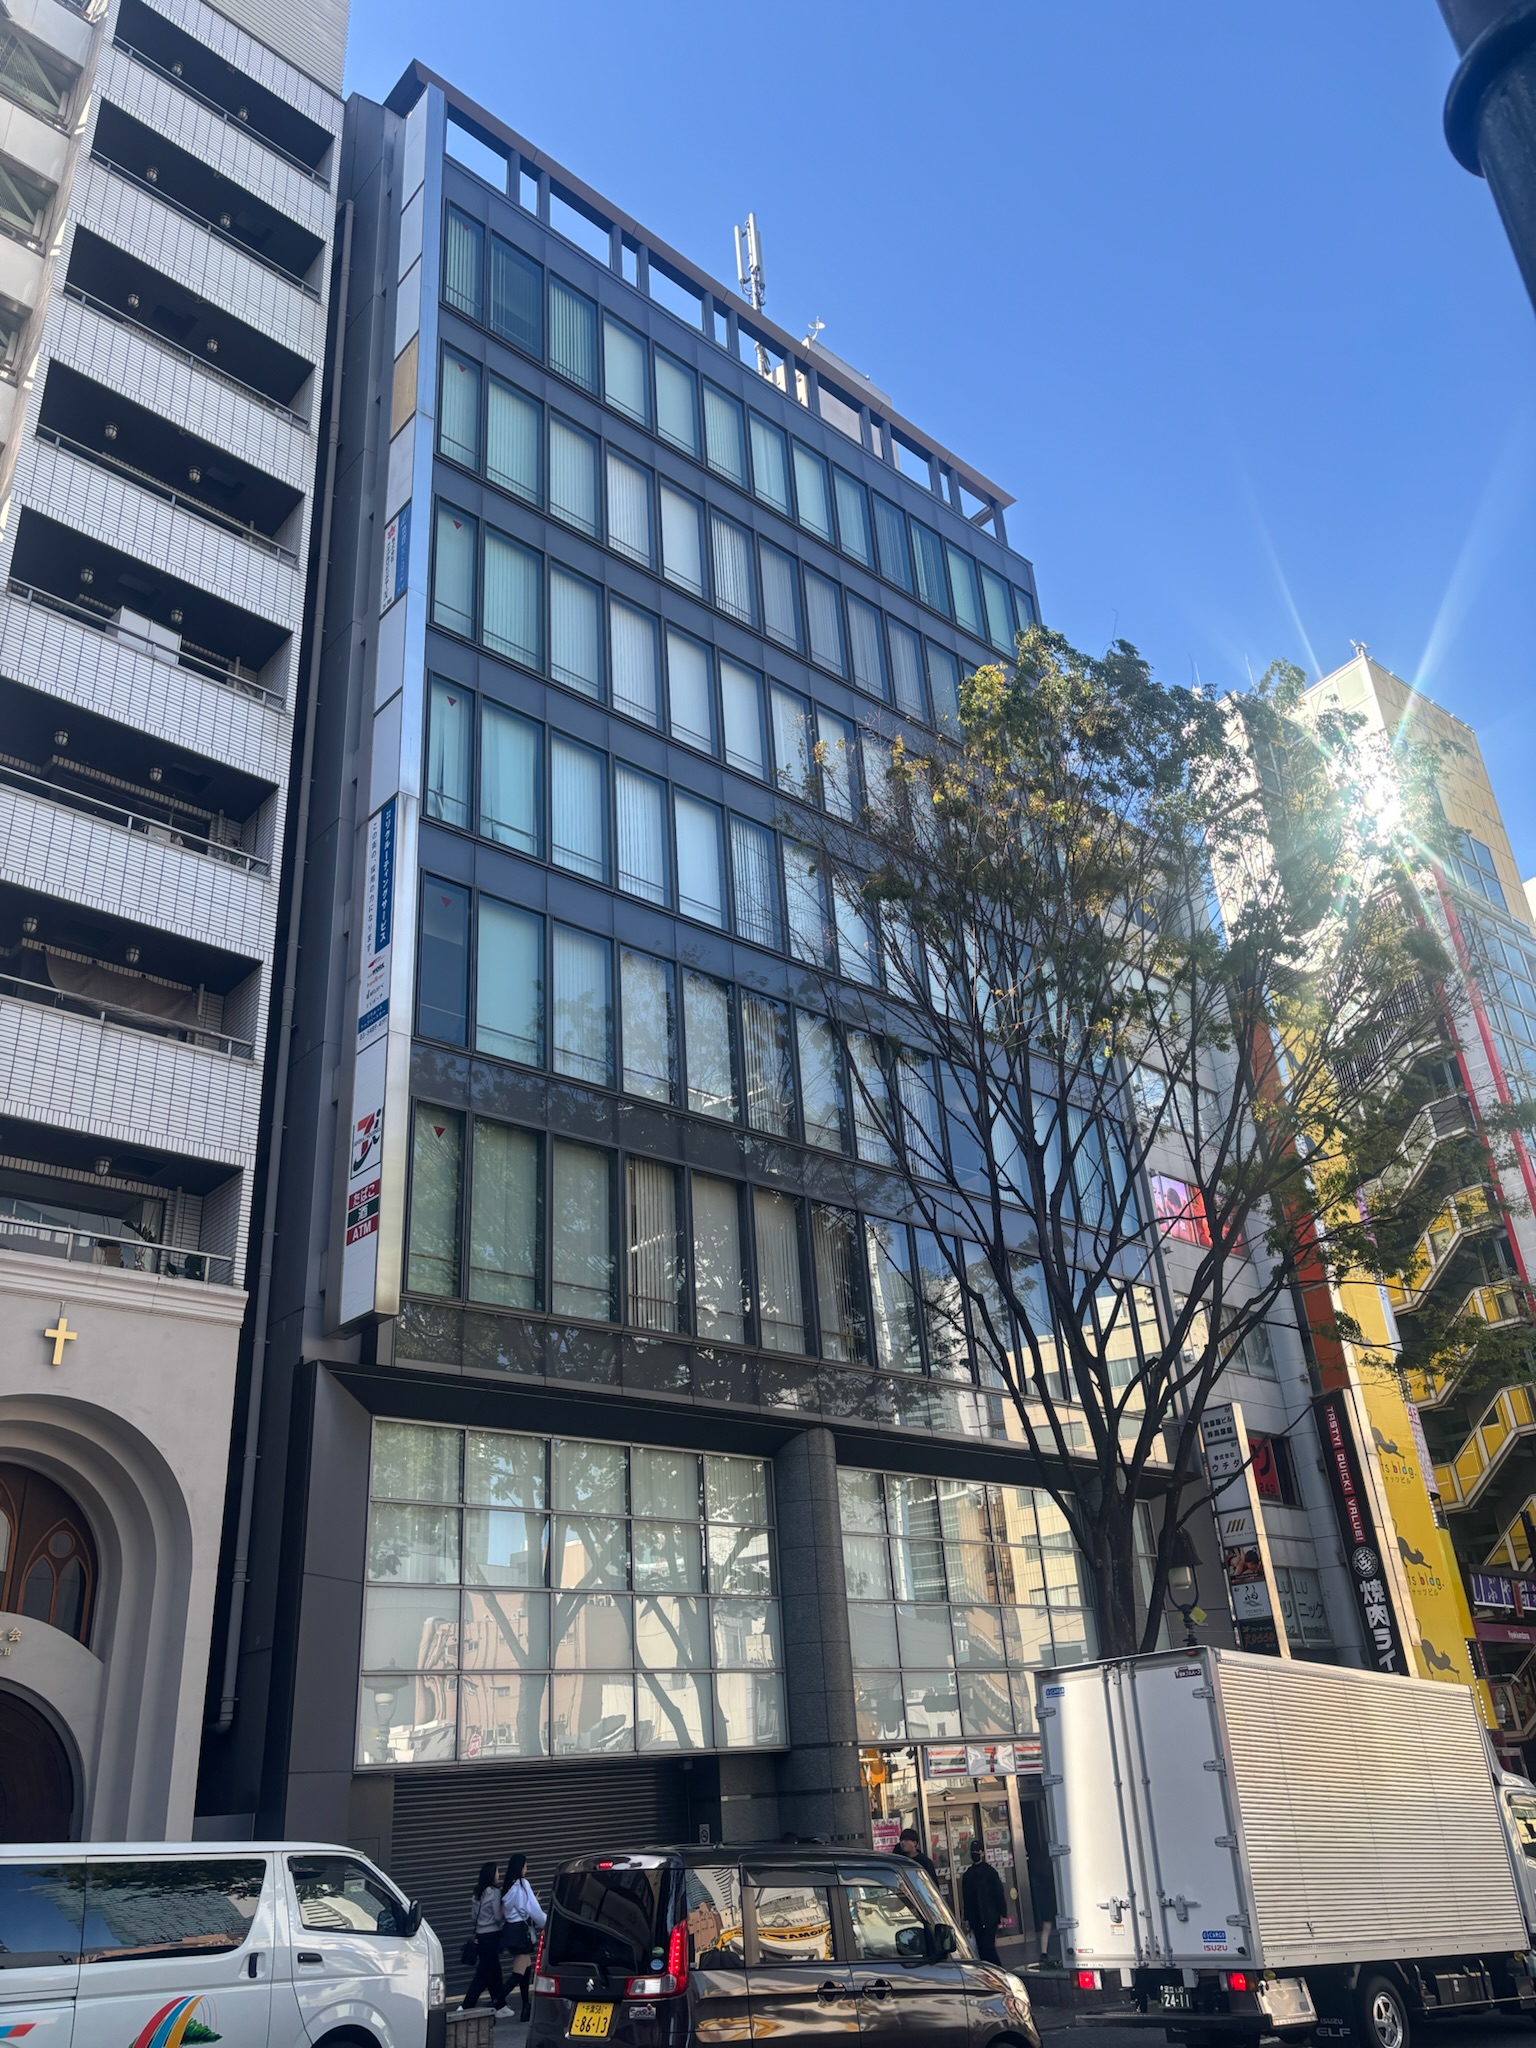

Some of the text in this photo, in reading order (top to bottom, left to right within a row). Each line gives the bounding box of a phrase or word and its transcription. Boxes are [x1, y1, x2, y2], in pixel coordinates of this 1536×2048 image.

[353, 1184, 375, 1206] たばこ
[358, 1204, 369, 1221] 酒
[352, 1219, 372, 1242] ATM
[1211, 1459, 1240, 1473] ウチダ
[1360, 1579, 1400, 1676] 焼肉ライ
[580, 2015, 608, 2033] 86-13
[1316, 2027, 1351, 2038] ELF
